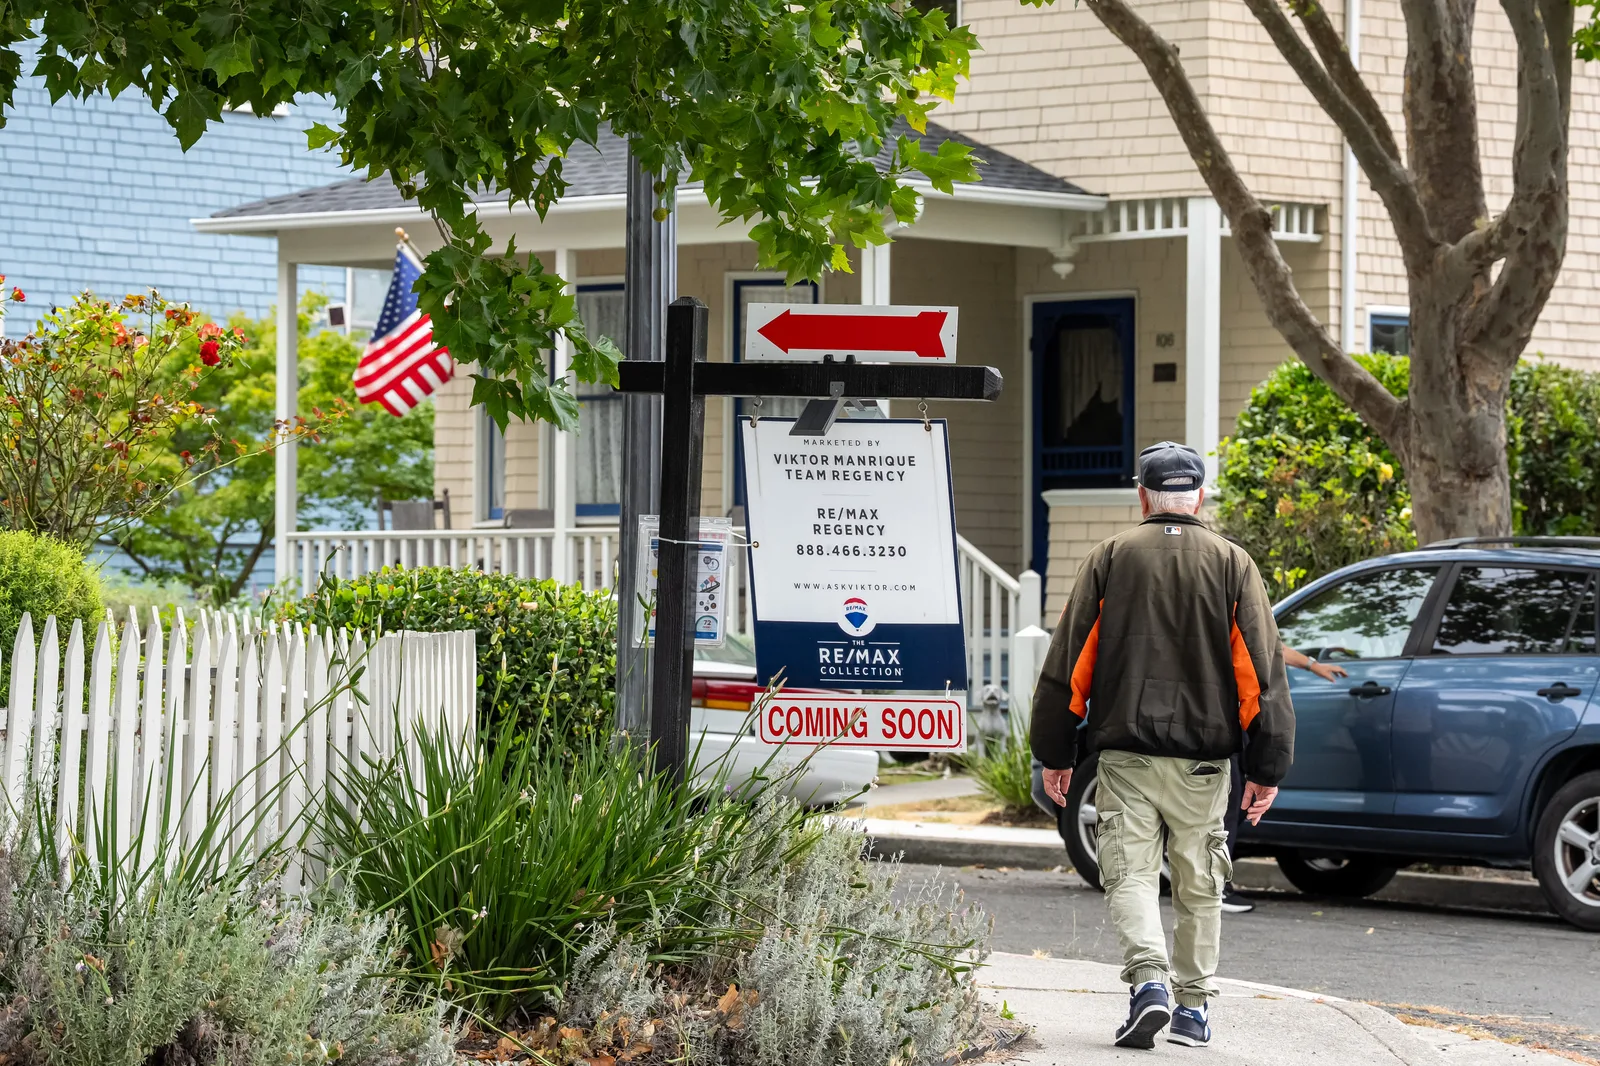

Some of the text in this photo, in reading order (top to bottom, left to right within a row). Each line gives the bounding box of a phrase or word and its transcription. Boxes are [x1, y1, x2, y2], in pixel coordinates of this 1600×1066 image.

[803, 438, 861, 446] MARKETED
[774, 454, 916, 467] VIKTOR MANRIQUE
[785, 469, 906, 482] TEAM REGENCY
[817, 508, 880, 520] RE/MAX
[813, 524, 886, 536] REGENCY
[796, 544, 907, 557] 888.466.3230
[794, 582, 916, 591] WWW.ASKVIKTOR.COM
[818, 648, 900, 665] RE/MAX
[820, 666, 902, 676] COLLECTION
[768, 706, 953, 740] COMING SOON
